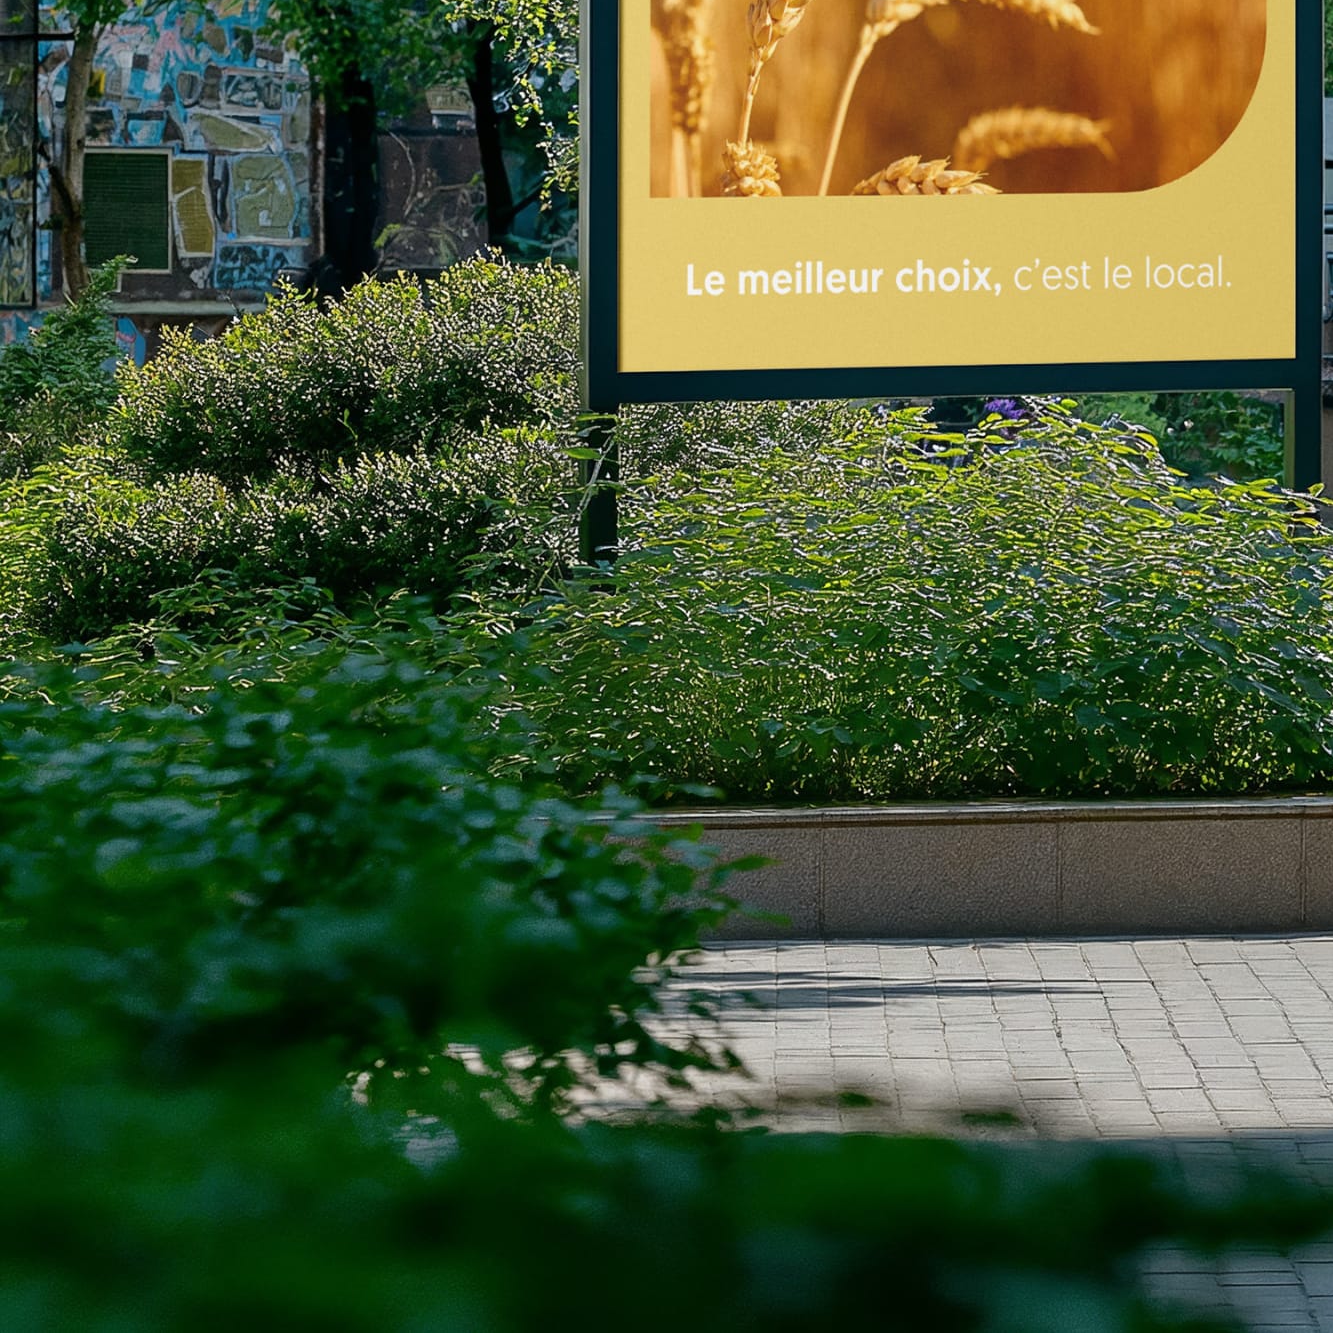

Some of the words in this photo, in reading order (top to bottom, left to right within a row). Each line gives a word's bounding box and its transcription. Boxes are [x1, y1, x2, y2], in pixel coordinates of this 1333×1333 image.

[686, 263, 726, 297] Le
[738, 260, 884, 296] meilleur
[895, 258, 1002, 297] choix,
[1104, 256, 1133, 290] le
[1145, 254, 1232, 289] local.
